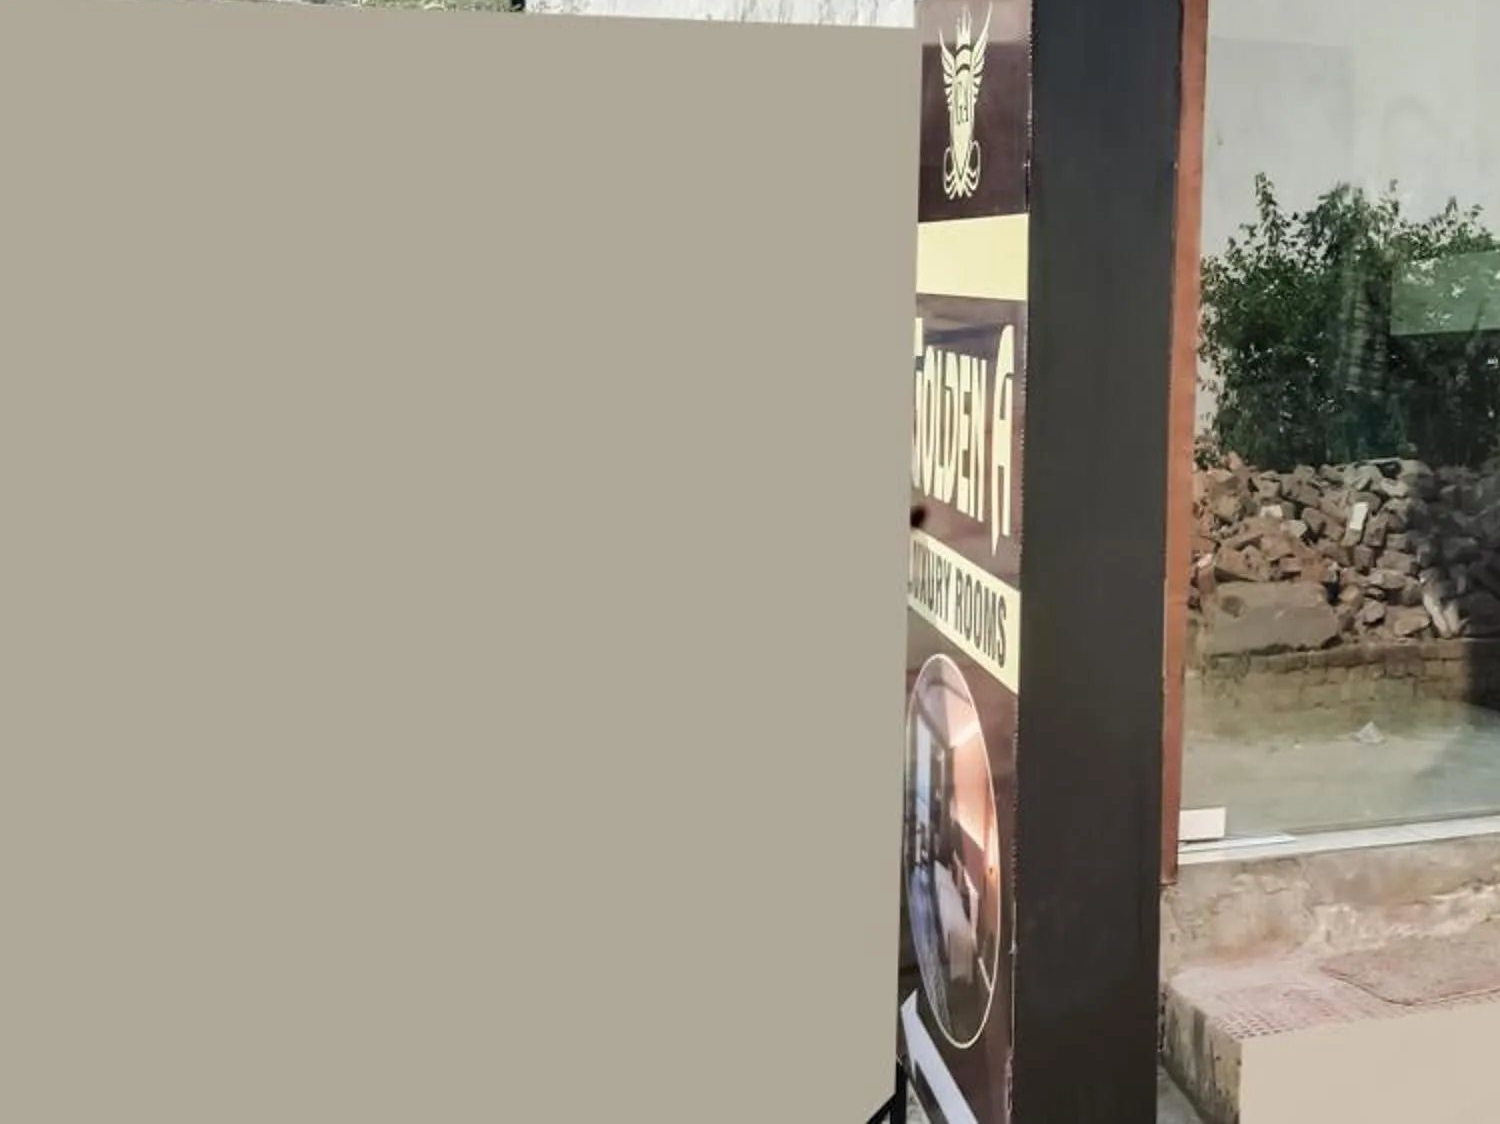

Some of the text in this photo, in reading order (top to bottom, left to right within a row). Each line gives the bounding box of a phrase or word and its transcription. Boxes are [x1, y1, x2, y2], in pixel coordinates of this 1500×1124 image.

[991, 324, 1014, 558] A
[908, 539, 1007, 669] UXURY ROOMS
